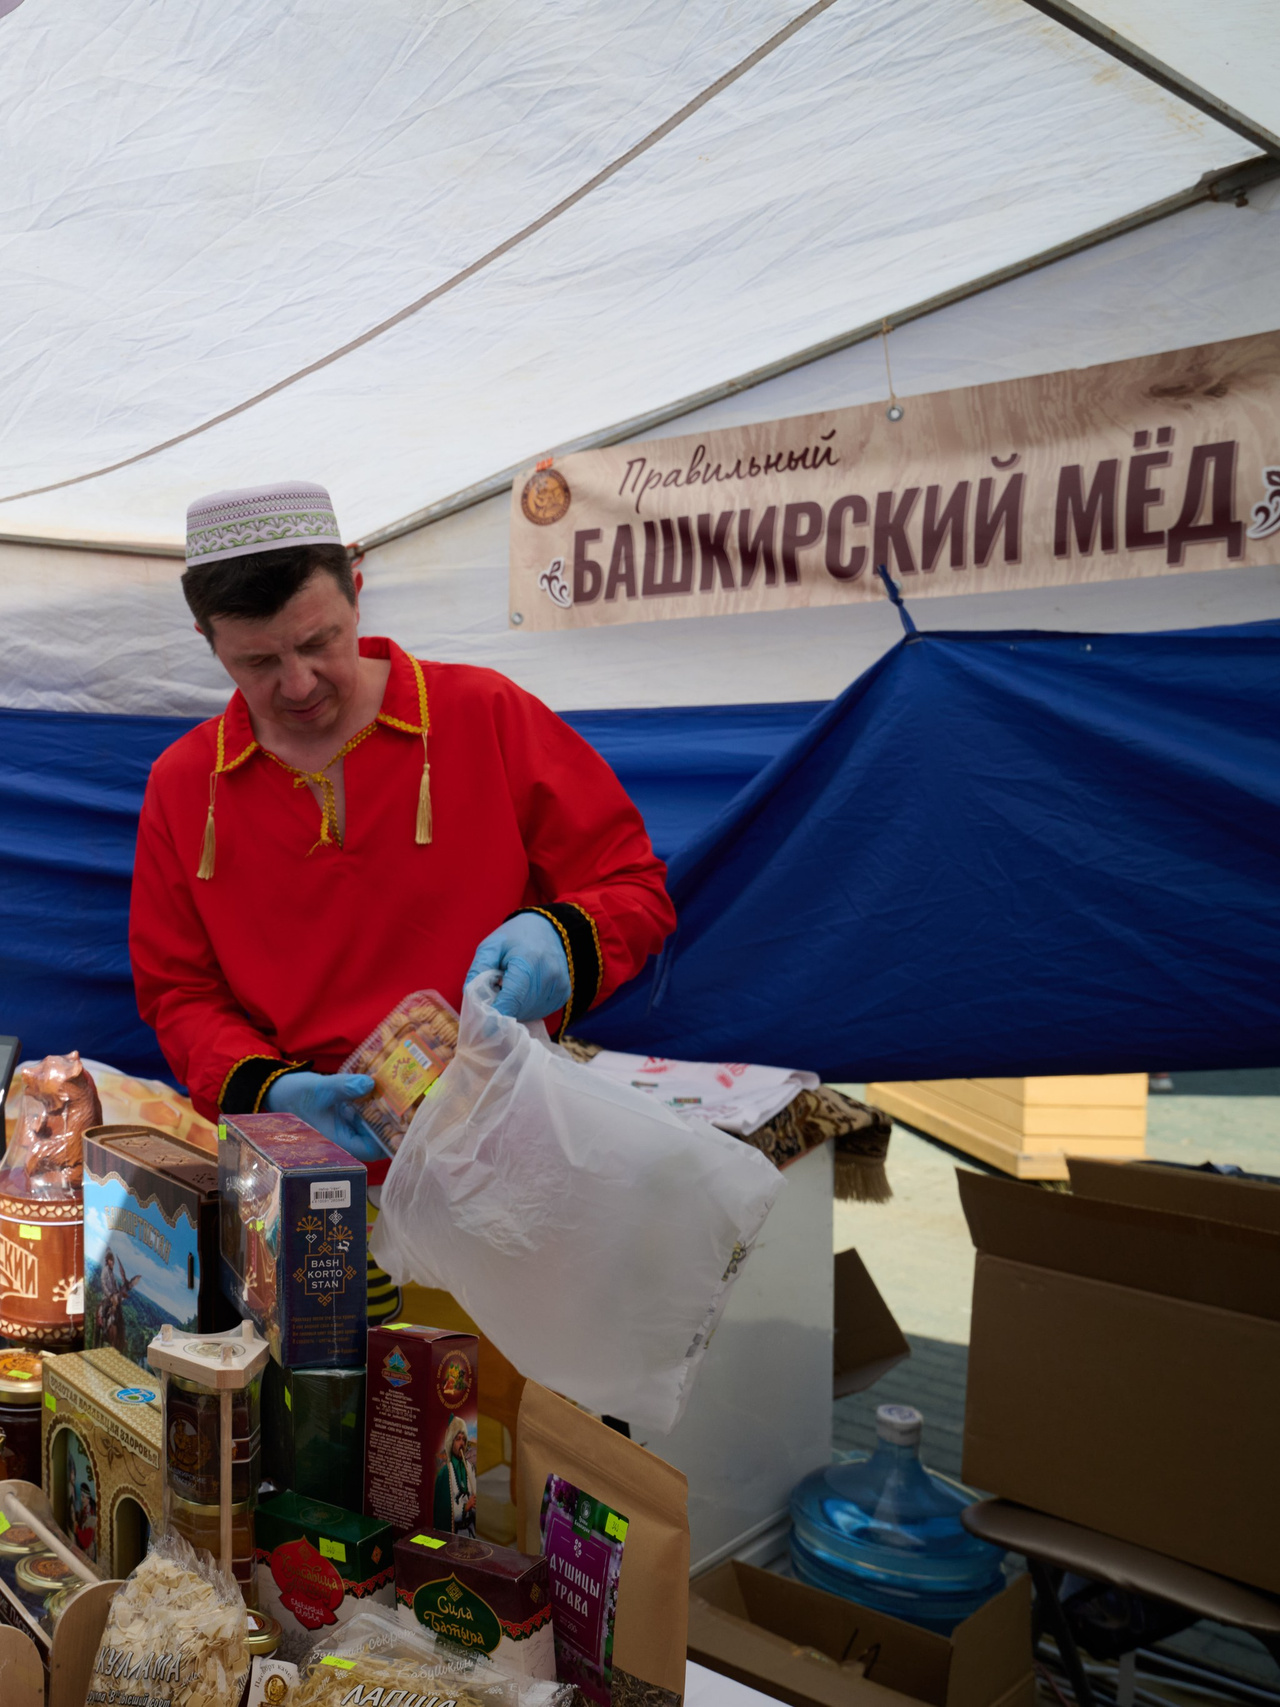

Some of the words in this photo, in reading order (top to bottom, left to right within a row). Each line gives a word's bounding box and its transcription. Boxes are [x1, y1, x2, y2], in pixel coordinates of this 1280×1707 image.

[617, 429, 841, 512] Правильный
[572, 452, 1028, 604] БАШКИРСКИЙ
[1052, 426, 1246, 565] МЁД
[307, 1269, 344, 1279] KORTO
[311, 1259, 340, 1269] BASH
[311, 1280, 340, 1289] STAN
[120, 1429, 158, 1467] ЗДОРОВЬЯ
[549, 1553, 600, 1599] ДУШИЦЫ
[437, 1596, 474, 1621] Сила
[554, 1580, 589, 1618] ТРАВА
[424, 1610, 486, 1646] Батыра
